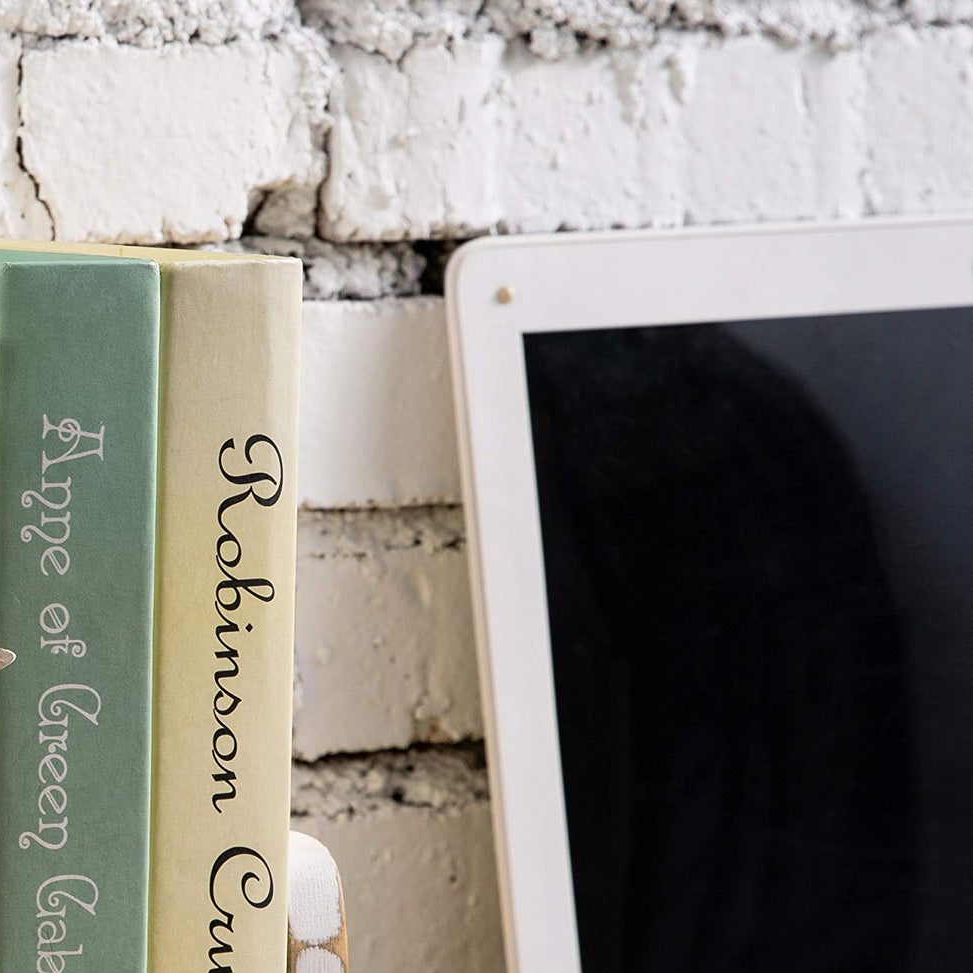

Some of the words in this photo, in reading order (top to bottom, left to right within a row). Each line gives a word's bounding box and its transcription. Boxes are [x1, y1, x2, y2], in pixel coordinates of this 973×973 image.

[20, 414, 105, 577] Anne
[39, 603, 87, 658] of
[211, 433, 283, 814] Robinson
[19, 683, 102, 850] Green
